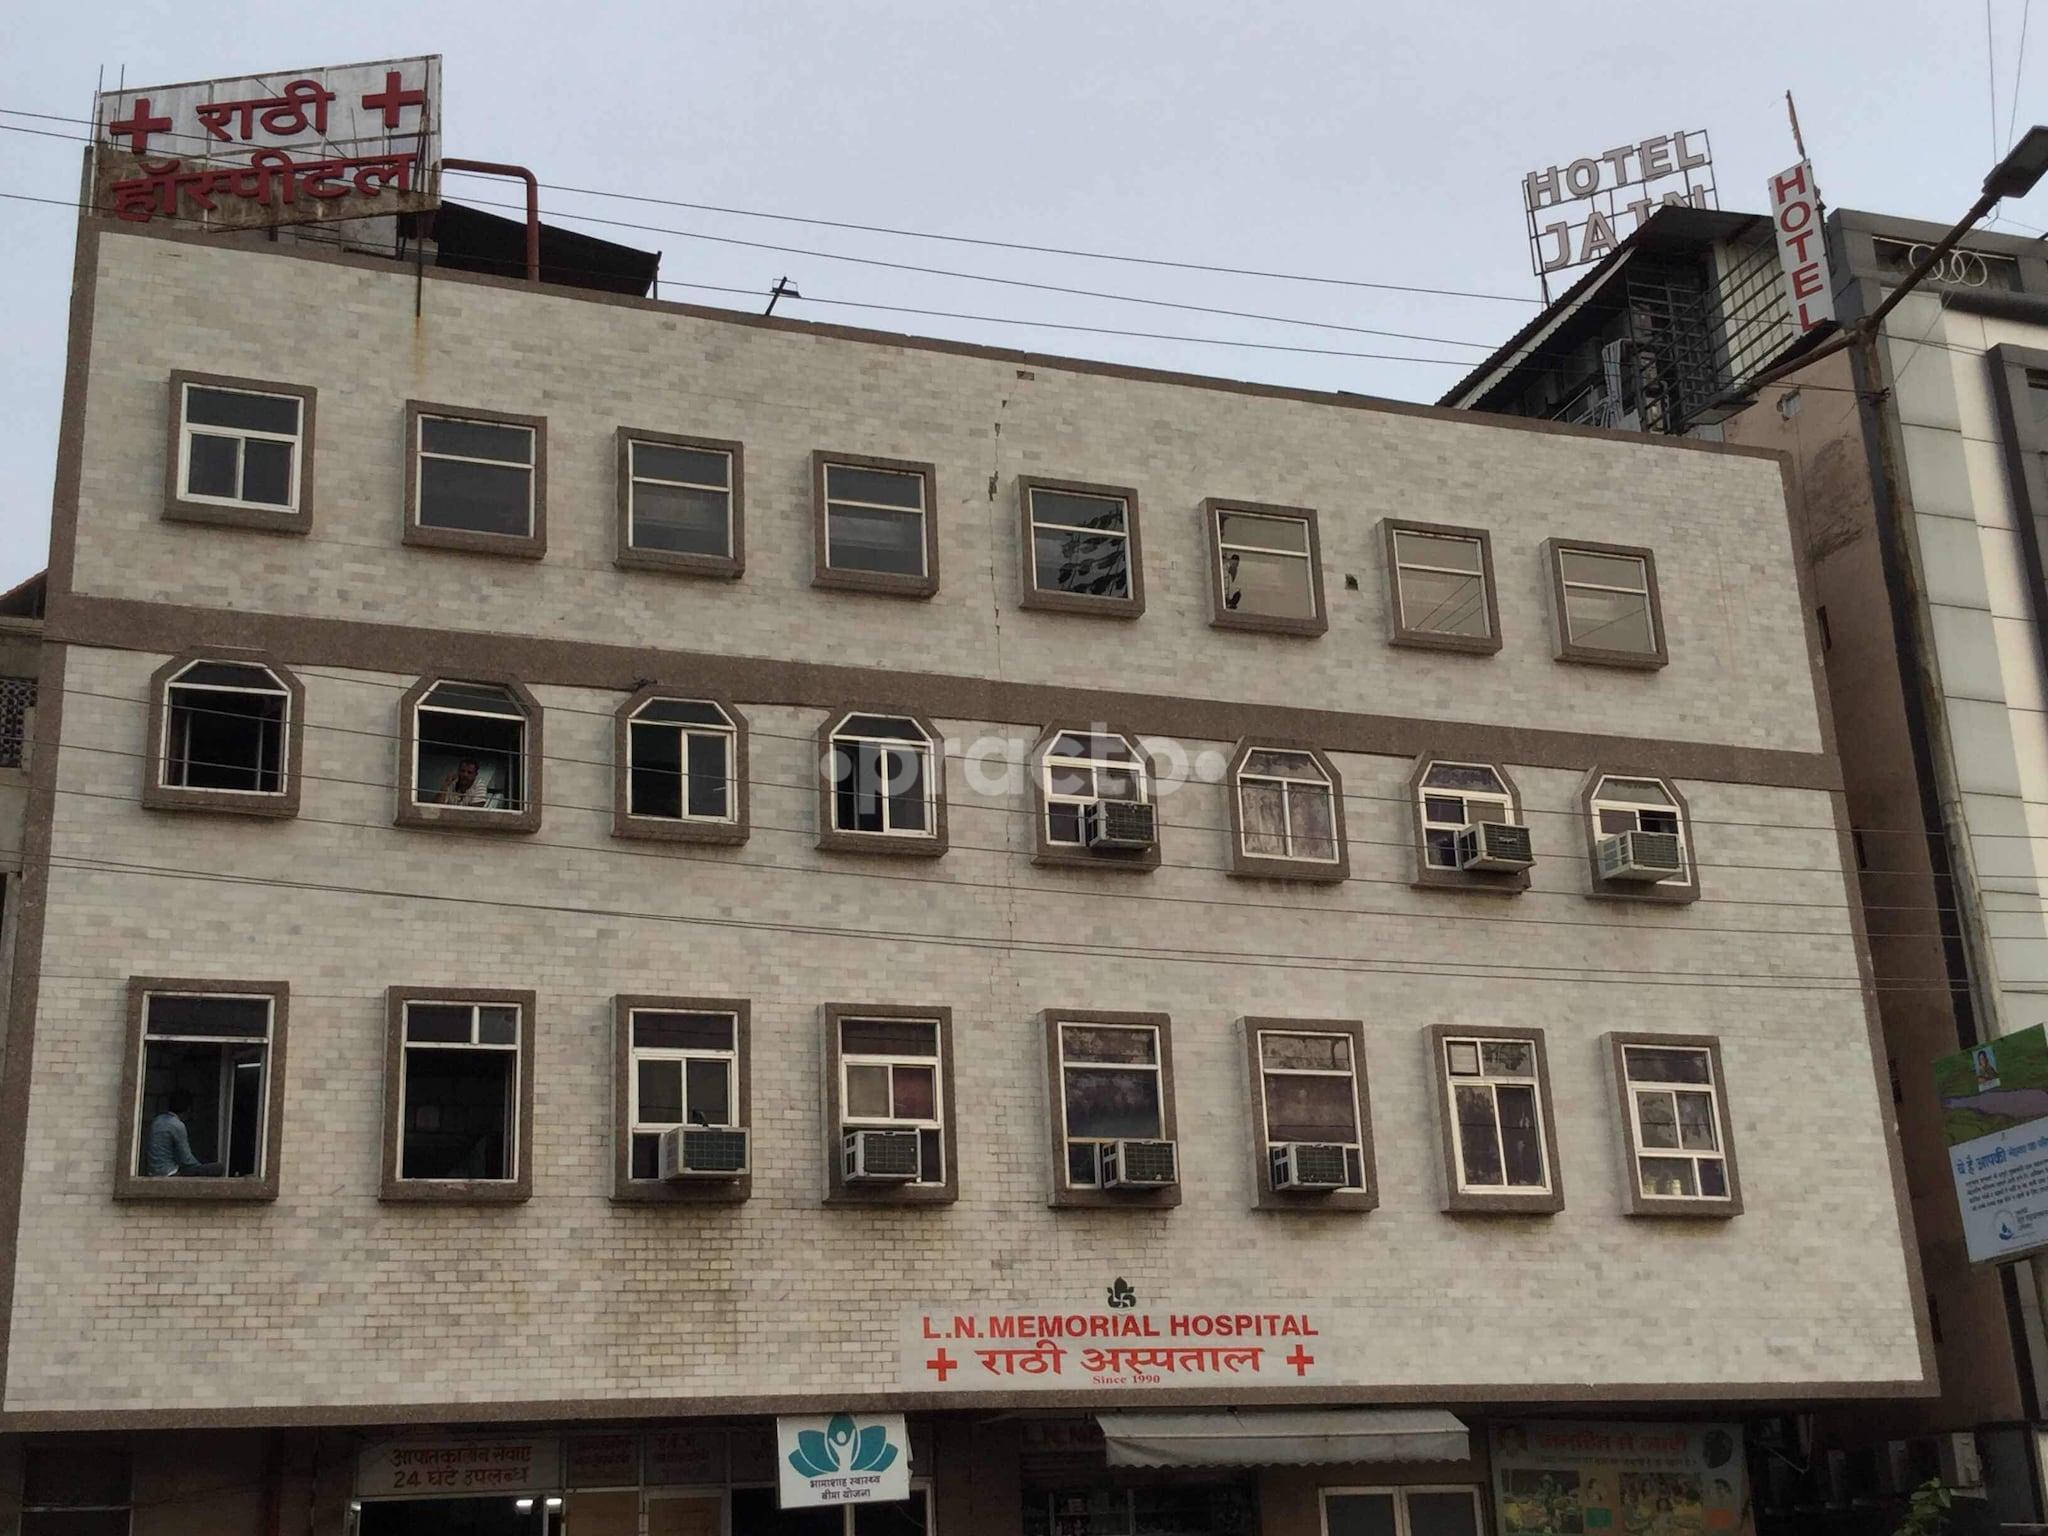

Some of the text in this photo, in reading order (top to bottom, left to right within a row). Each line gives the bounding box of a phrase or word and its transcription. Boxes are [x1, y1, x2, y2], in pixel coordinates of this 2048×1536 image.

[196, 79, 336, 143] राठी
[1527, 131, 1705, 211] HOTEL
[1774, 165, 1827, 333] HOTEL
[1170, 1314, 1319, 1337] HOSPITAL
[975, 1339, 1264, 1375] राठी अस्पताल
[1093, 1374, 1161, 1385] Since 1990
[393, 1470, 421, 1488] 24
[464, 1467, 529, 1486] उपलब्ध
[821, 1487, 871, 1500] बीमा योजना
